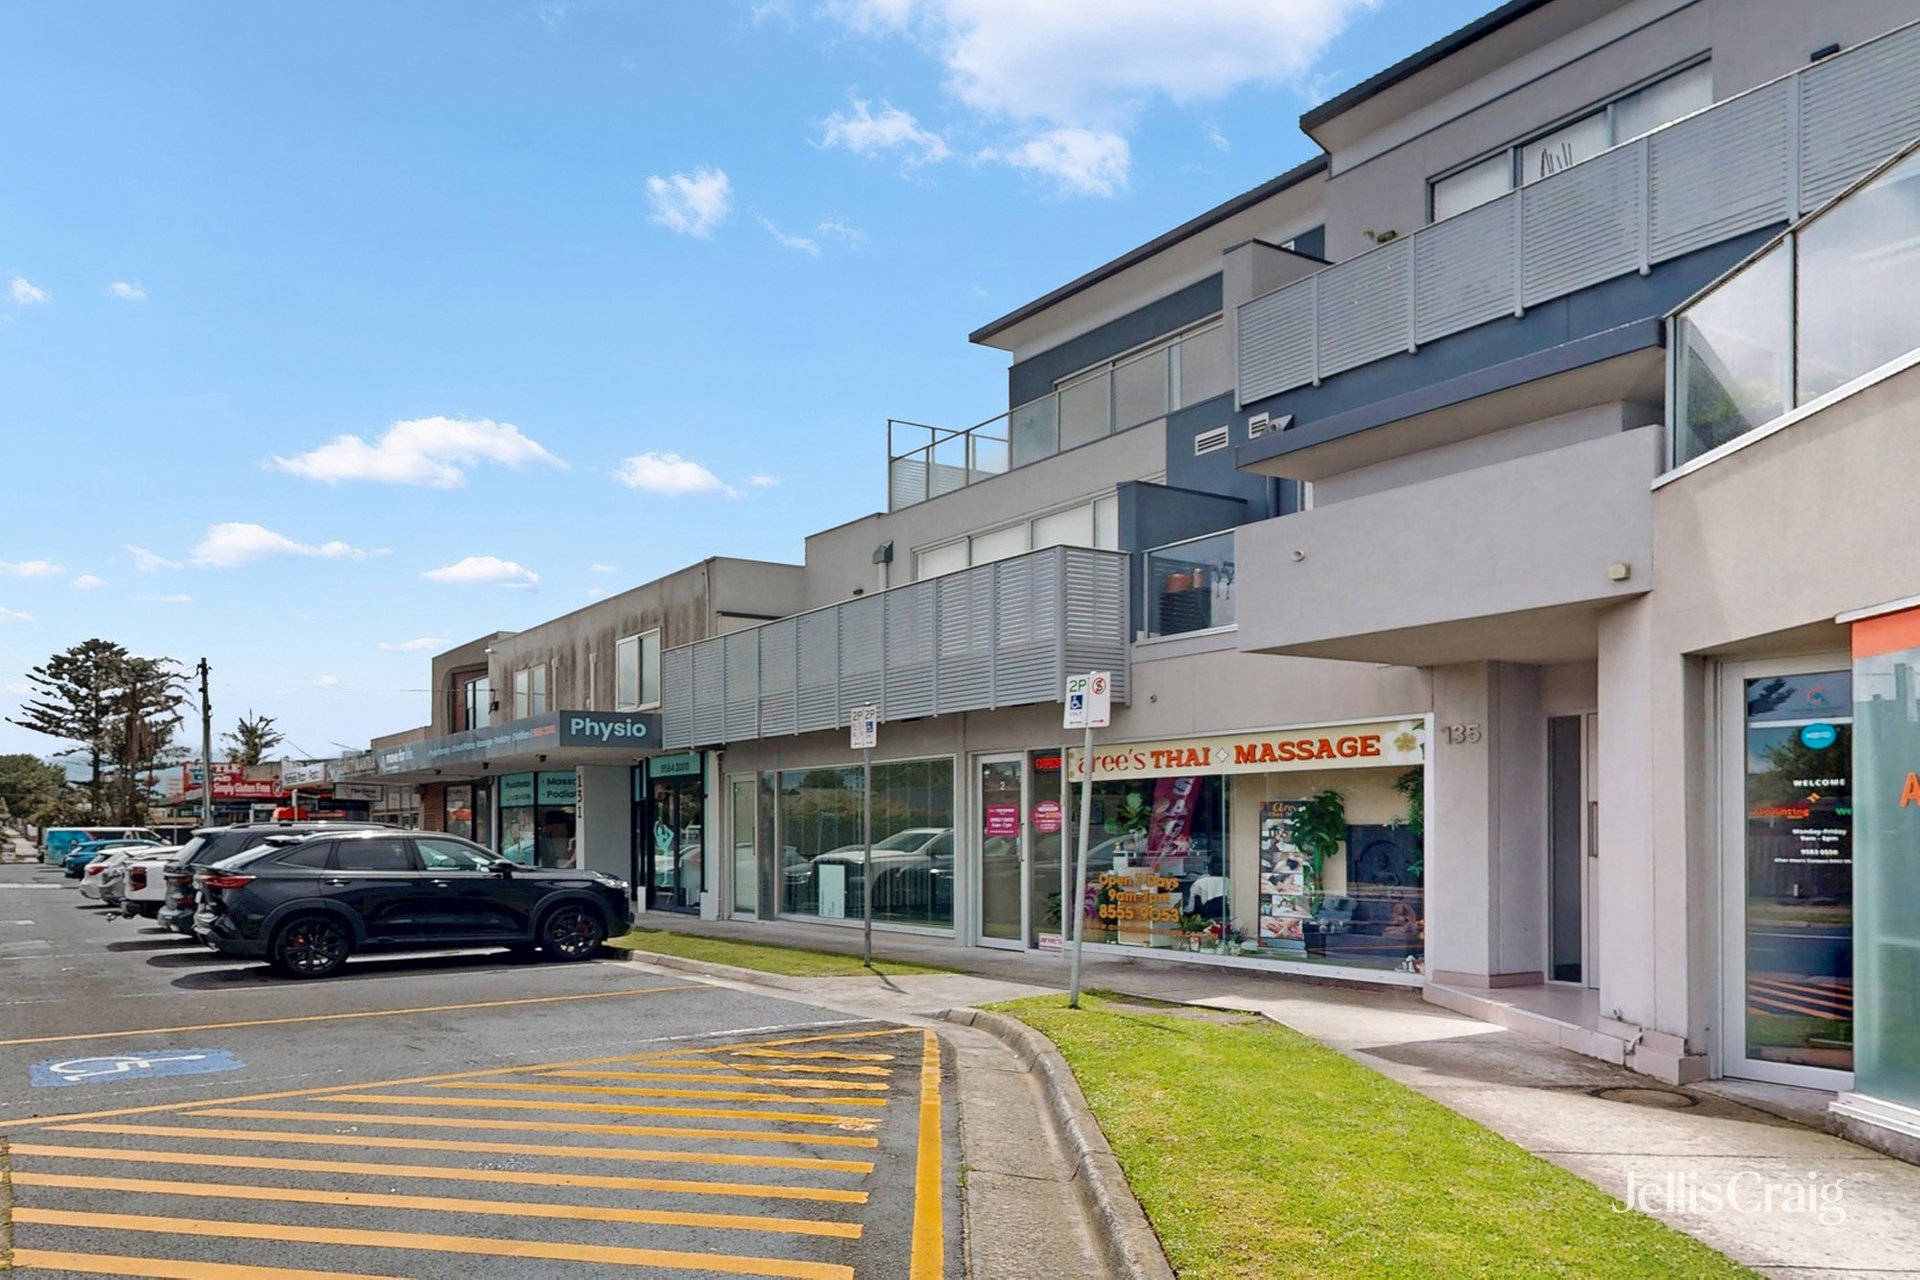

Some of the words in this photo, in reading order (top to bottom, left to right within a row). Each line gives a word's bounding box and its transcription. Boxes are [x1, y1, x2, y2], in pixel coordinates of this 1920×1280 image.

[1069, 679, 1087, 692] 2P
[853, 711, 863, 721] 2P
[865, 709, 875, 720] 2P
[570, 718, 647, 741] Physio
[1441, 724, 1482, 744] 135
[1150, 747, 1211, 769] THAI
[1234, 735, 1381, 764] MASSAGE
[1000, 782, 1006, 790] 2
[1793, 779, 1845, 787] WELCOME
[1099, 873, 1132, 887] Open
[1136, 874, 1143, 884] 7
[1146, 874, 1179, 890] Days
[1099, 904, 1134, 919] 8555
[1140, 908, 1180, 923] 9053
